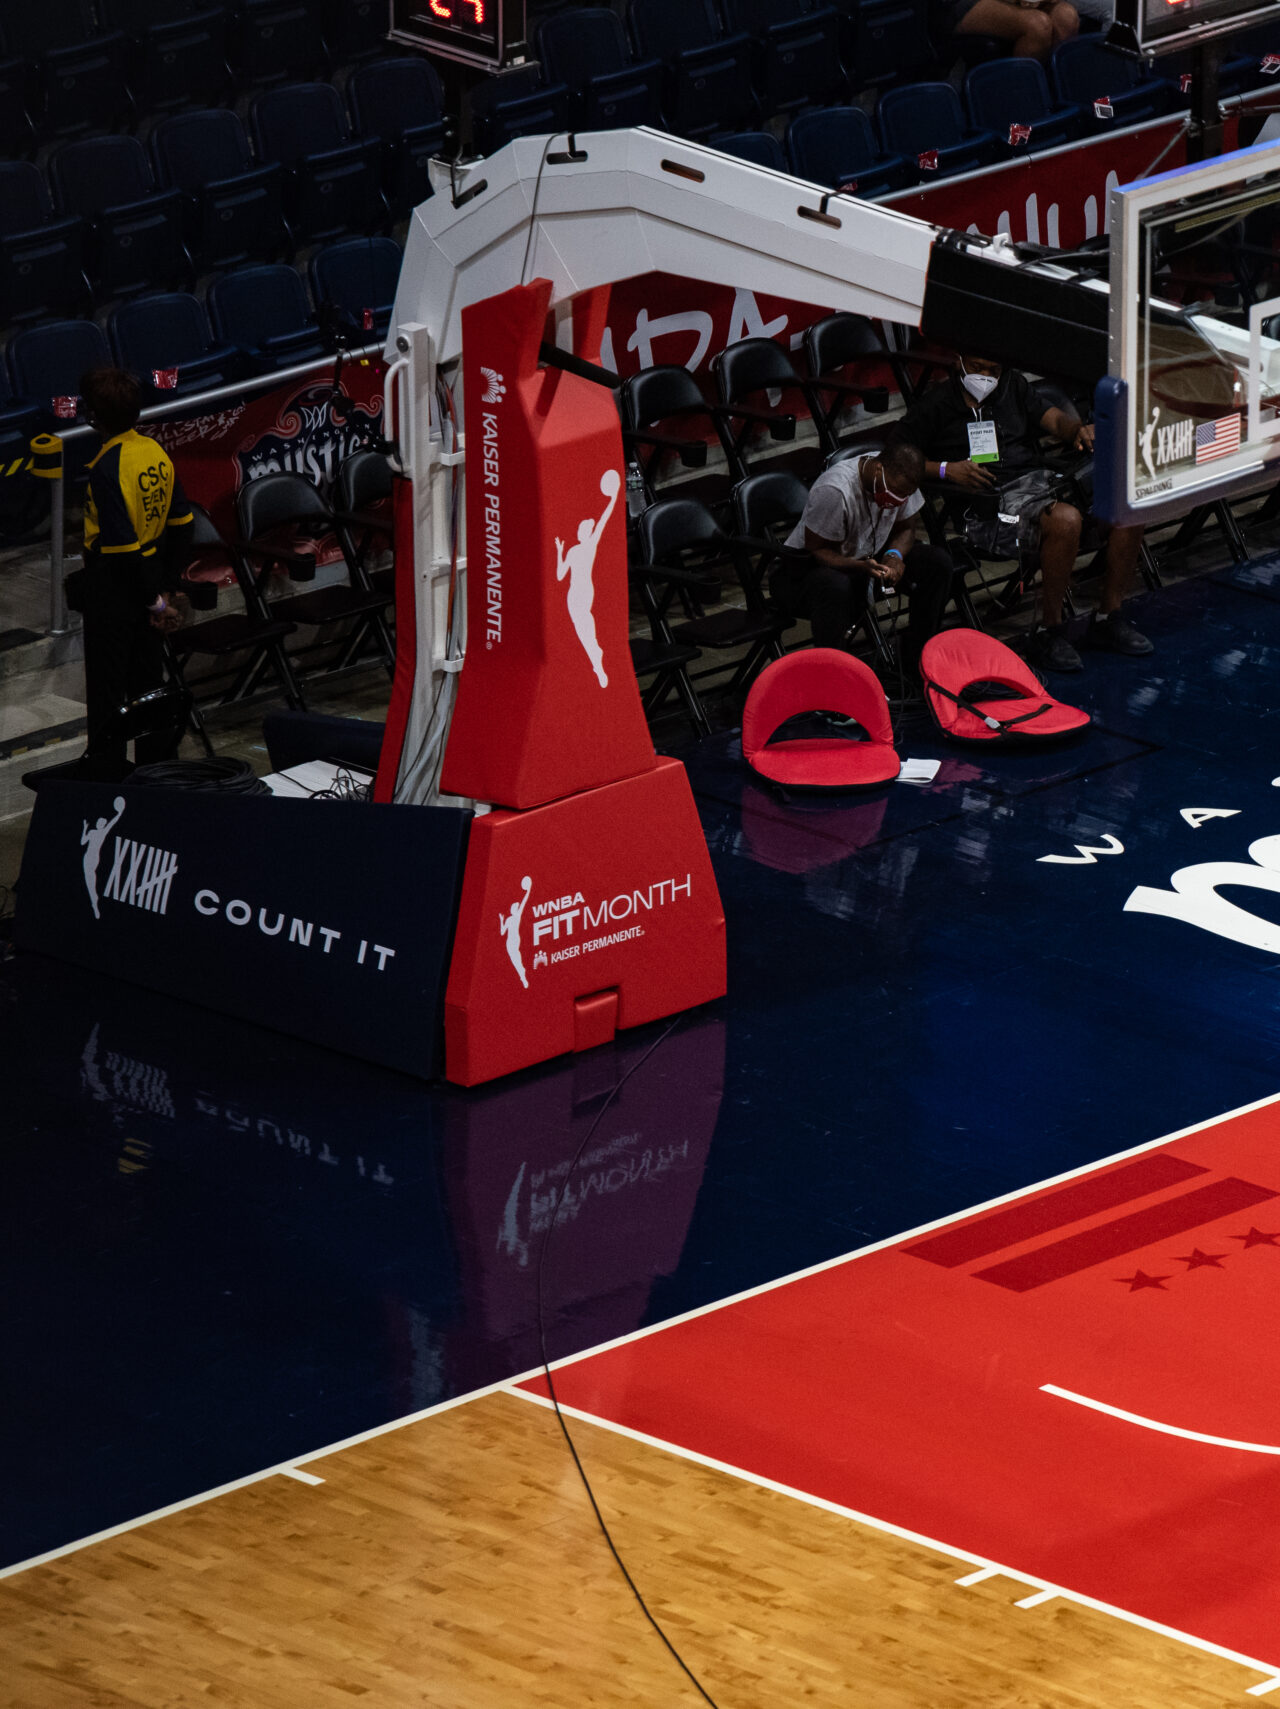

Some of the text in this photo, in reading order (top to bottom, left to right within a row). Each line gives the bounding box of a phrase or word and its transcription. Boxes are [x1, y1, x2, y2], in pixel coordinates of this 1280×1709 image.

[482, 411, 501, 486] KAISER
[138, 461, 169, 492] CSC
[1135, 478, 1172, 500] SPALDING
[532, 892, 585, 918] WNBA
[194, 889, 342, 953] COUNT
[357, 940, 396, 971] IT
[551, 945, 580, 964] KAISER
